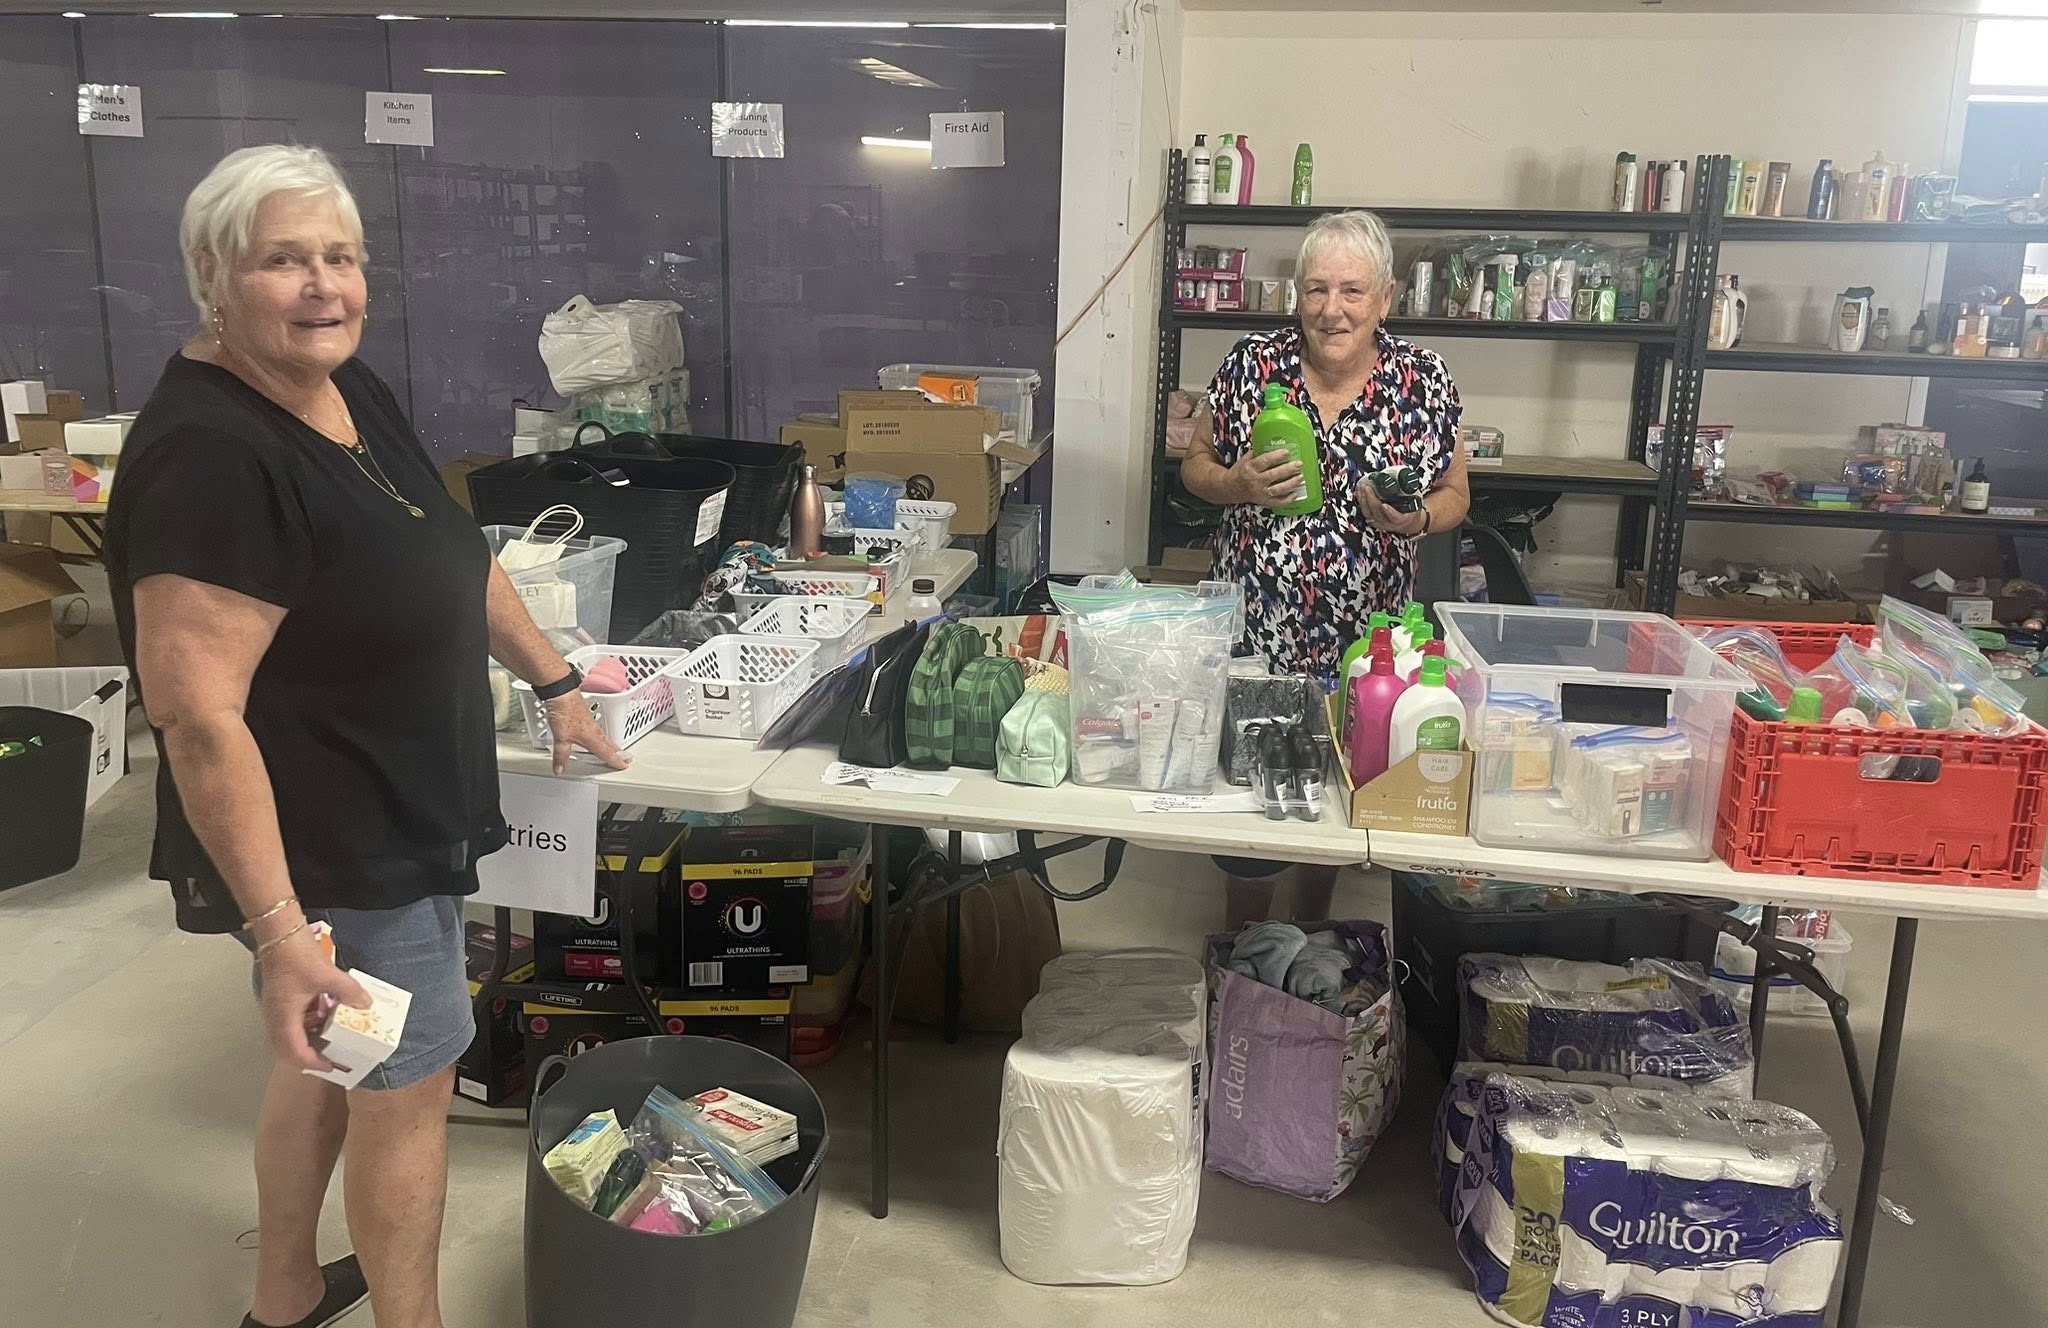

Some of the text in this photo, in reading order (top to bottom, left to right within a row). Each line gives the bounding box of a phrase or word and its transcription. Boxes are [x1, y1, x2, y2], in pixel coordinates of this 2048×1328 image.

[95, 95, 125, 105] Men's
[383, 101, 415, 110] Kitchen
[90, 110, 131, 122] Clothes
[387, 116, 411, 125] Items
[944, 122, 989, 133] First Aid
[728, 128, 768, 141] Products
[735, 905, 762, 933] U
[574, 938, 618, 947] ULTRATHINS
[726, 946, 771, 954] ULTRATHINS
[1222, 1034, 1249, 1120] adairs
[1589, 1201, 1740, 1254] Quilton
[1519, 1248, 1561, 1268] PACK
[1621, 1308, 1674, 1327] 3 PLY
